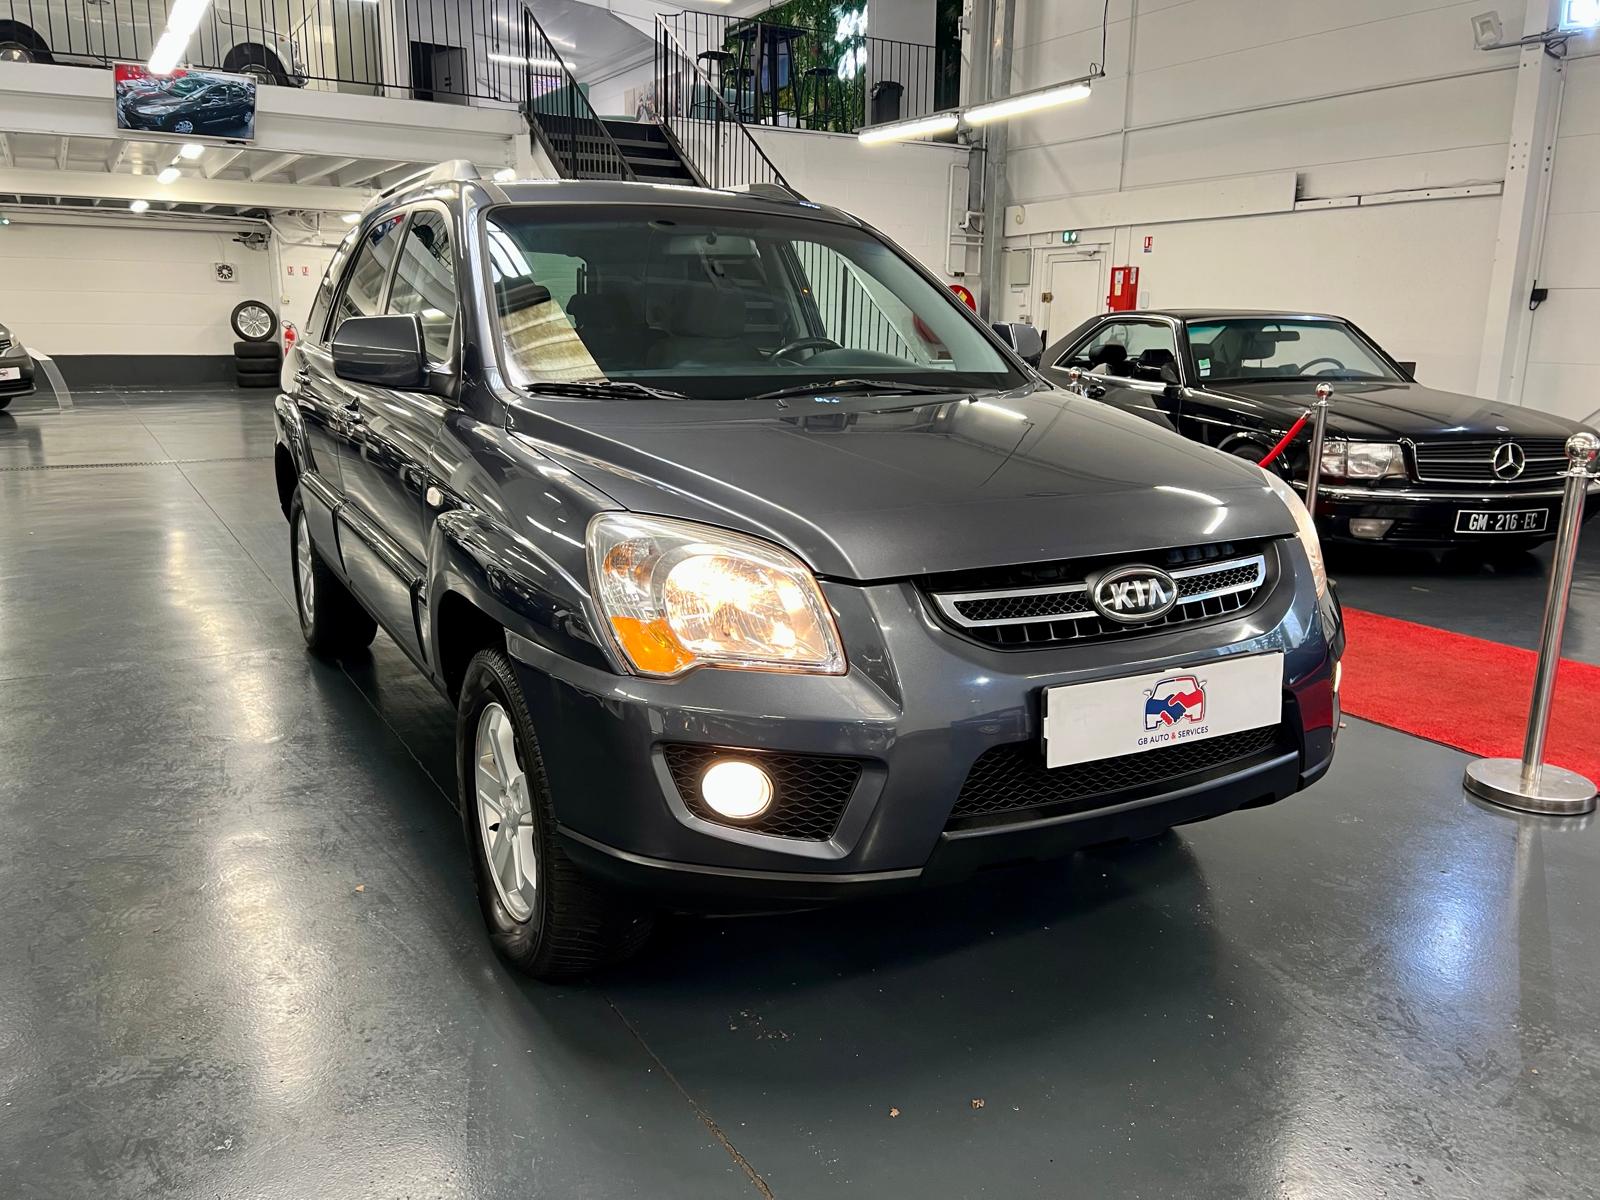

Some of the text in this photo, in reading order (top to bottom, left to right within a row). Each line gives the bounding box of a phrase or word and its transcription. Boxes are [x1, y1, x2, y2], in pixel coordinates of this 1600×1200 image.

[1109, 578, 1168, 610] KIA
[1137, 725, 1209, 746] GB AUTO & SERVICES
